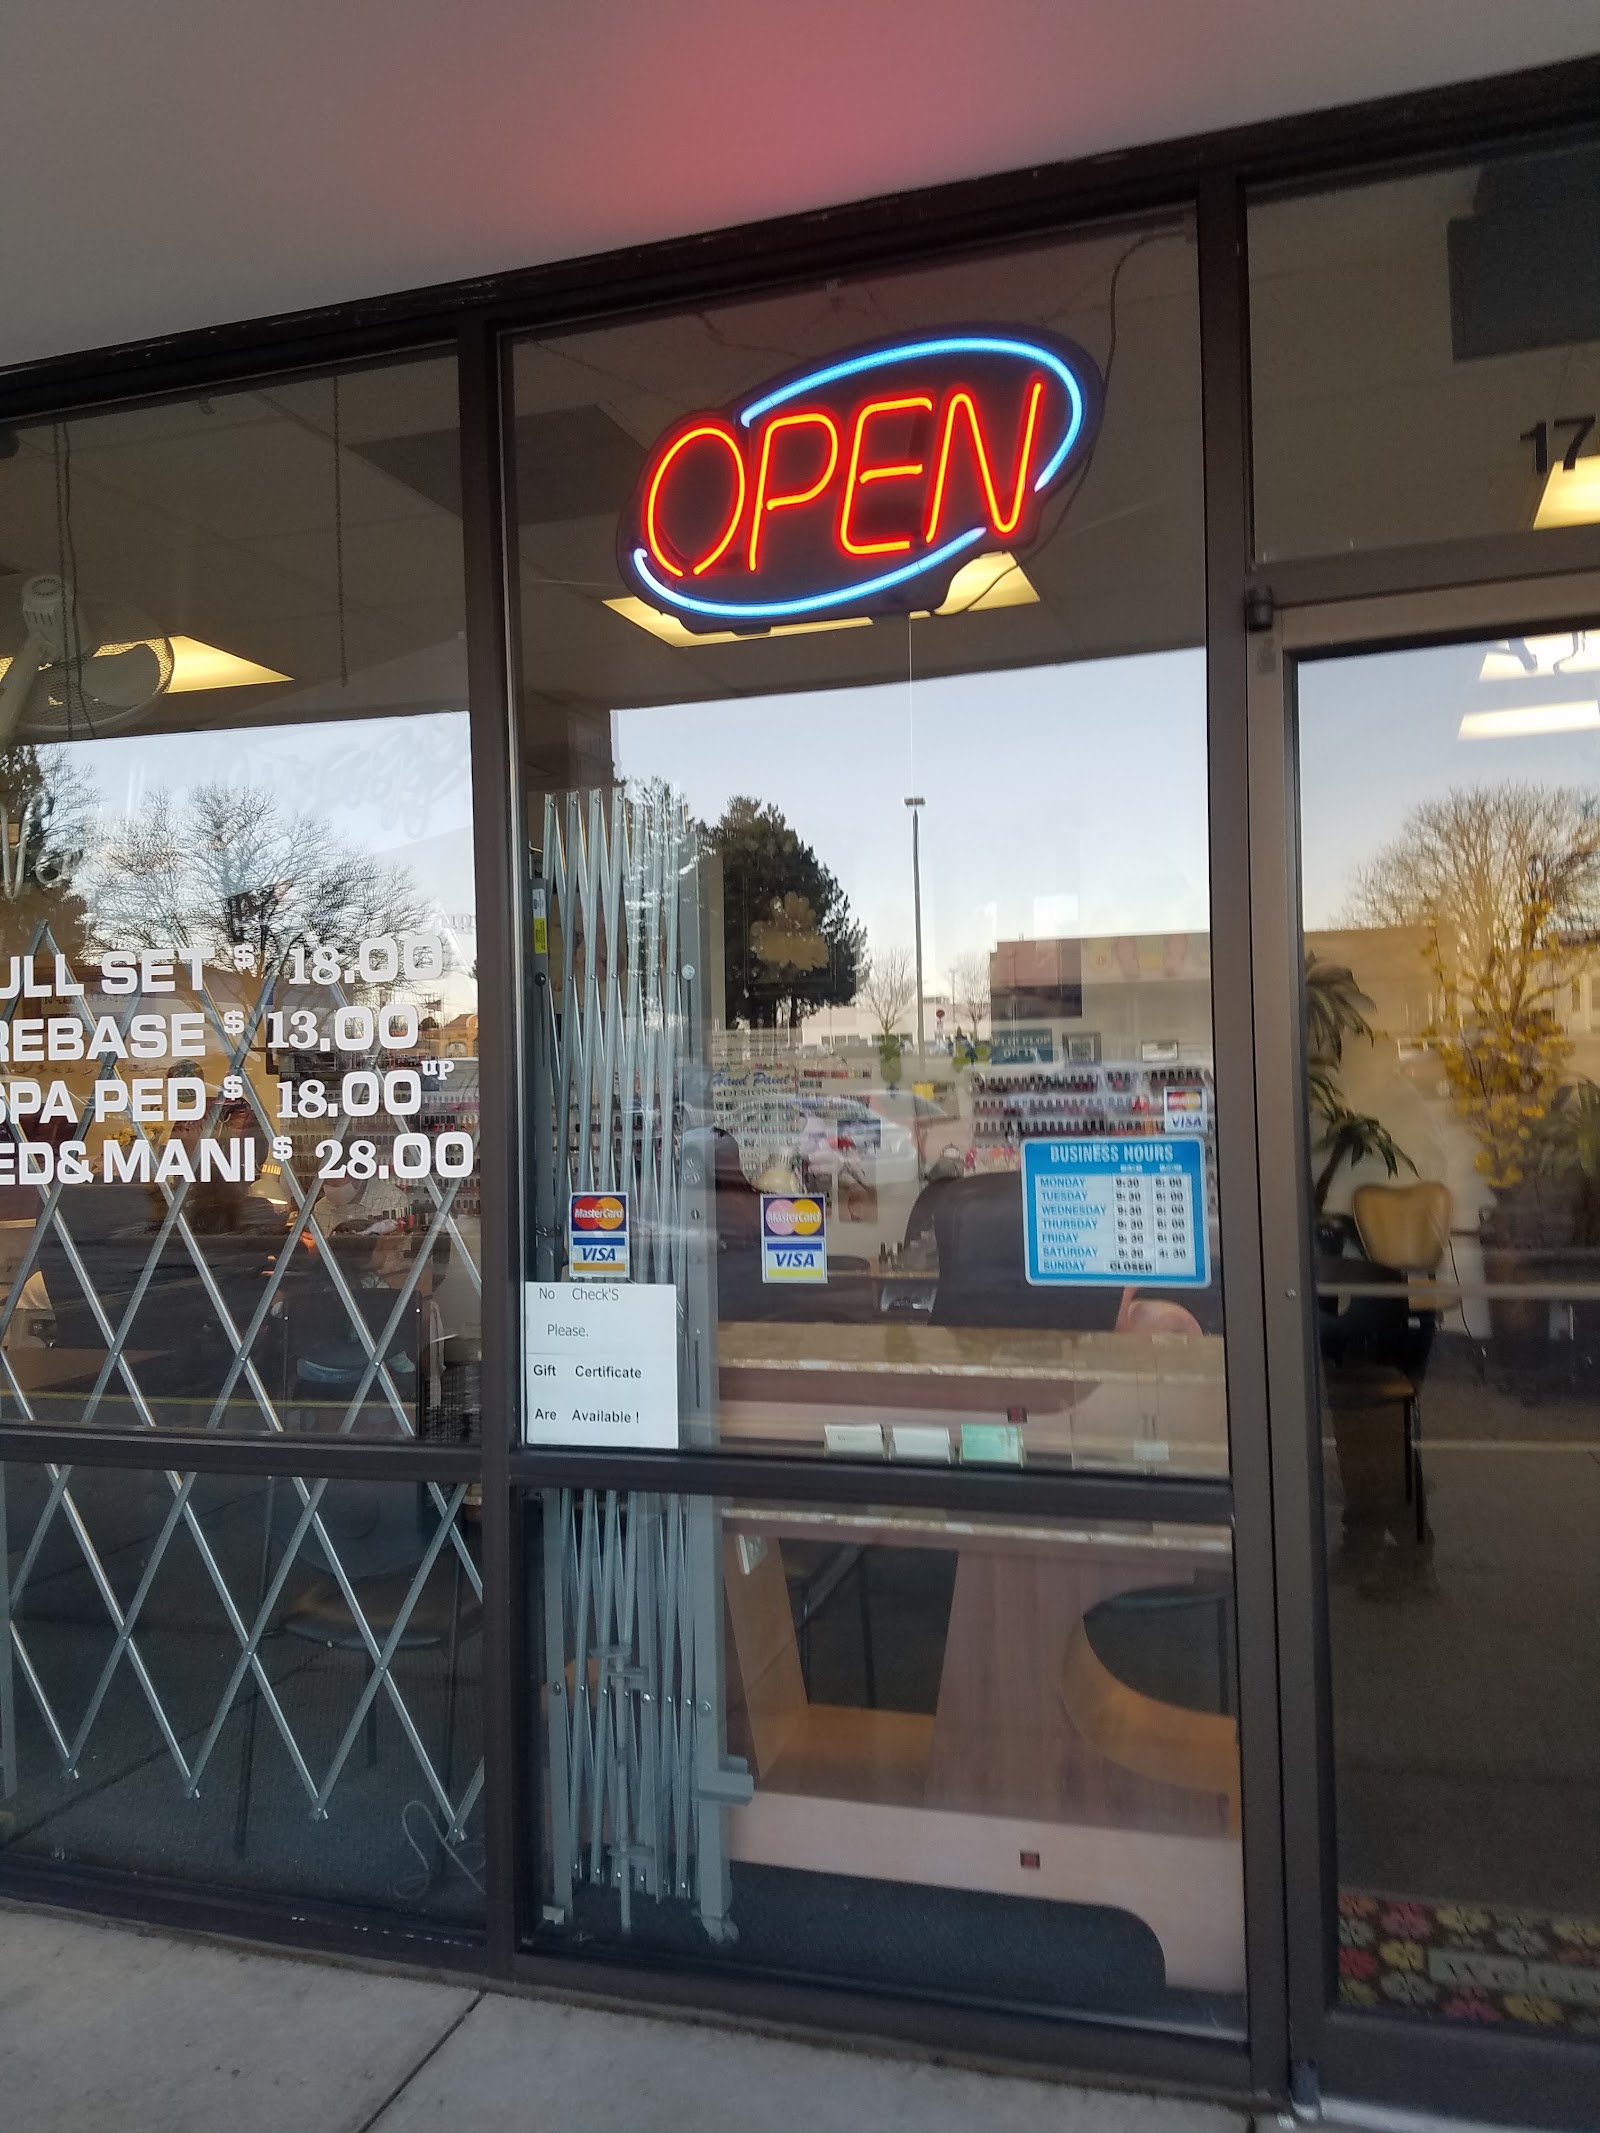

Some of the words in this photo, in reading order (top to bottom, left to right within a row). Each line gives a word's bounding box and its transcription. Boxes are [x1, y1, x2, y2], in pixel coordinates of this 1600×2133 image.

[1520, 415, 1596, 473] 17
[647, 380, 1043, 577] OPEN
[101, 947, 215, 996] SET
[233, 943, 255, 970] $
[290, 934, 443, 985] 18.00
[0, 1012, 206, 1063] EBASE
[224, 1010, 245, 1036] $
[267, 1003, 419, 1052] 13.00
[0, 1080, 78, 1124] PA
[95, 1077, 206, 1123] PED
[223, 1074, 243, 1101] $
[276, 1069, 422, 1118] 18.00
[1171, 1116, 1202, 1128] VISA
[103, 1137, 256, 1183] MANI
[272, 1135, 293, 1161] $
[315, 1131, 474, 1179] 28.00
[1050, 1144, 1119, 1163] BUSINESS
[1124, 1144, 1174, 1162] HOURS
[1040, 1178, 1085, 1187] MONDAY
[1041, 1191, 1087, 1201] TUESDAY
[574, 1207, 625, 1220] MasterCard
[766, 1210, 822, 1224] MasterCard
[1041, 1205, 1106, 1215] WEDNESDAY
[1042, 1219, 1098, 1230] THURSDAY
[1042, 1233, 1079, 1243] FRIDAY
[581, 1247, 617, 1262] VISA
[1043, 1246, 1098, 1257] SATURDAY
[775, 1253, 815, 1269] VISA
[1043, 1261, 1086, 1271] SUNDAY
[1110, 1262, 1152, 1273] CLOSED
[538, 1287, 556, 1300] No
[572, 1287, 620, 1301] Check'S
[547, 1323, 589, 1338] Please.
[533, 1364, 557, 1377] Gift
[575, 1365, 642, 1379] Certificate
[534, 1409, 557, 1422] Are
[572, 1409, 632, 1424] Available
